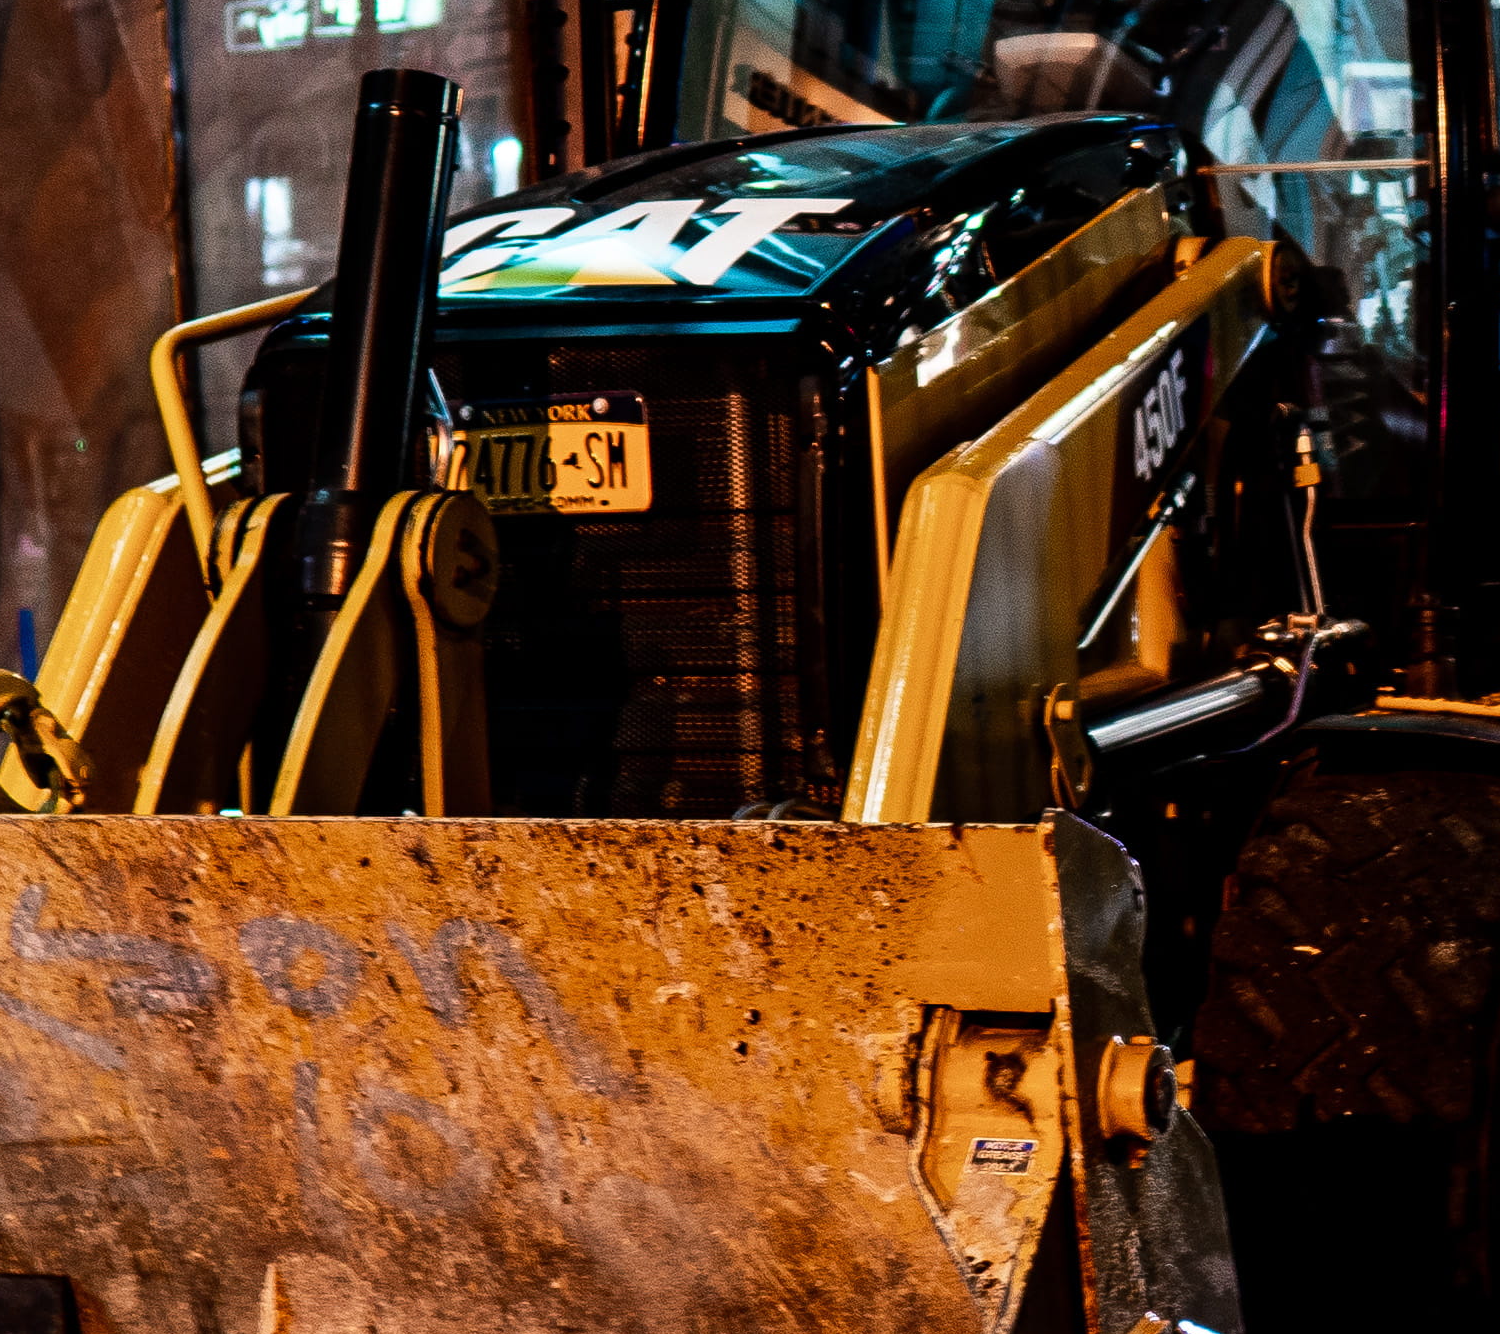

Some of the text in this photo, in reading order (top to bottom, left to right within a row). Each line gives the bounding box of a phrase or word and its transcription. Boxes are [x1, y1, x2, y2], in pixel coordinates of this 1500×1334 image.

[440, 198, 855, 286] CAT
[537, 403, 594, 422] YORK
[1133, 348, 1188, 482] 450F
